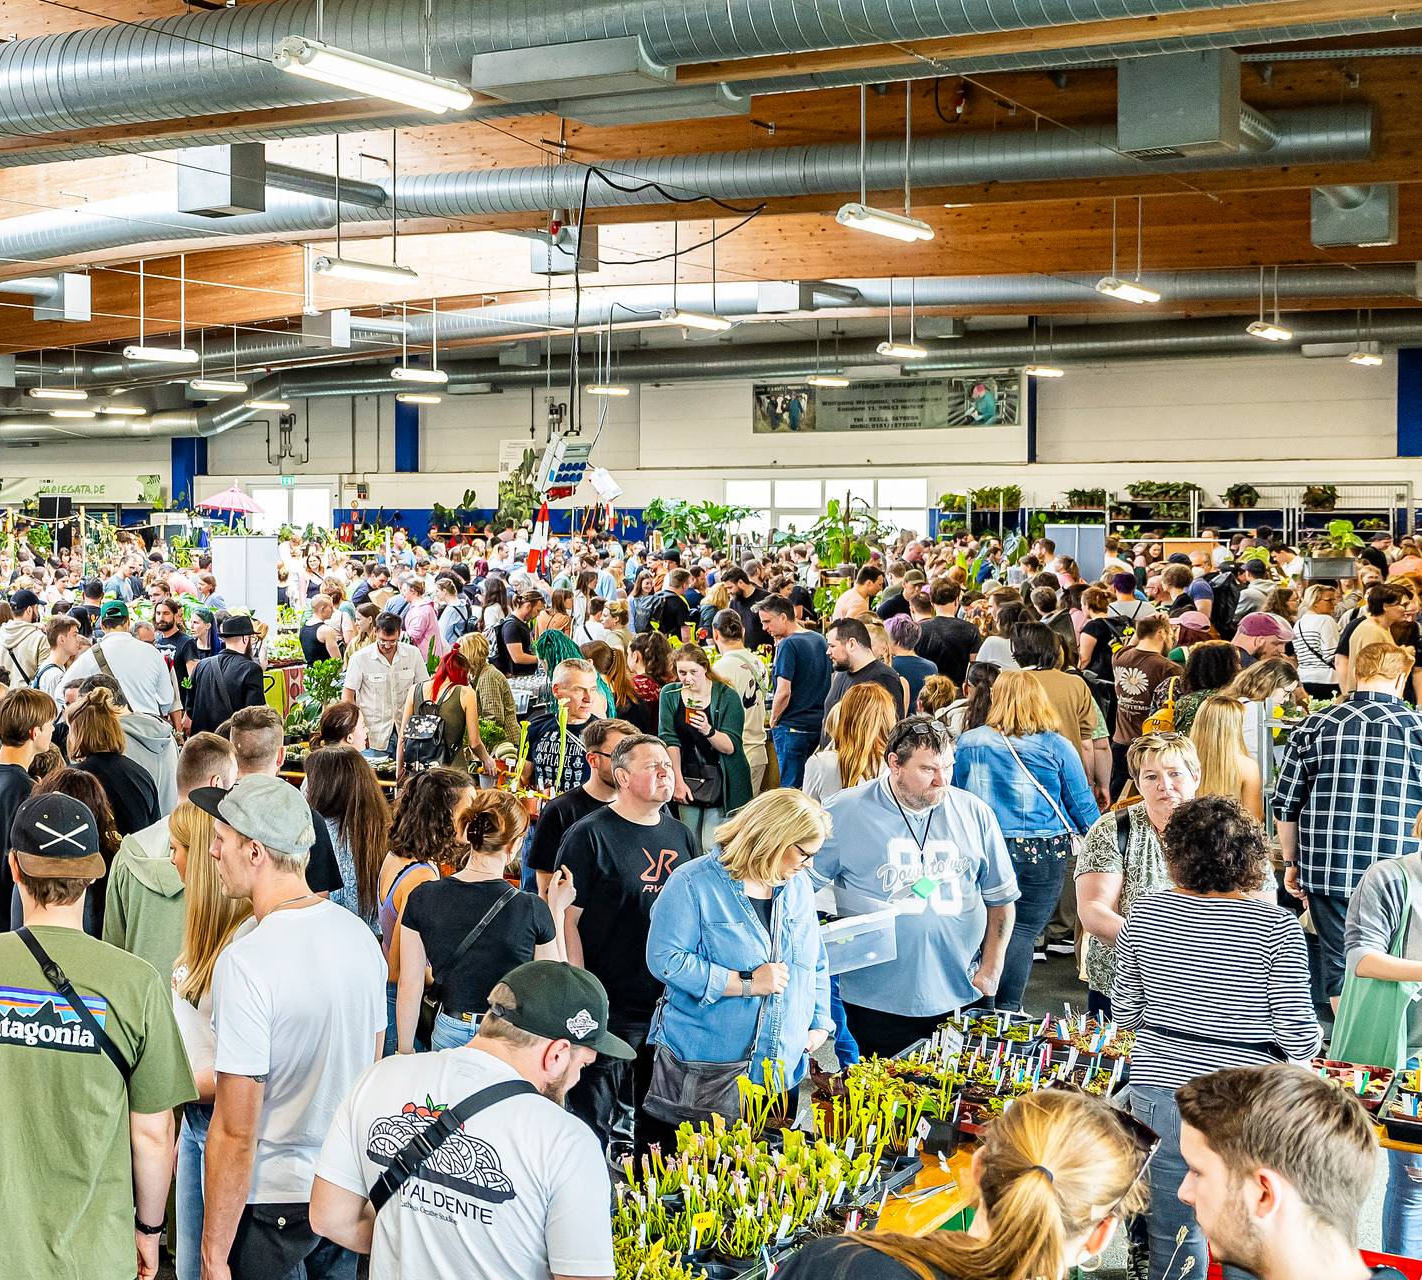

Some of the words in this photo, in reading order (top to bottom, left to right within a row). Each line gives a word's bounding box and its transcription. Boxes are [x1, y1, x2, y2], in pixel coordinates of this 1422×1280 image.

[542, 753, 571, 768] PFLAZE
[410, 1184, 431, 1205] AL
[433, 1190, 494, 1226] DENTE
